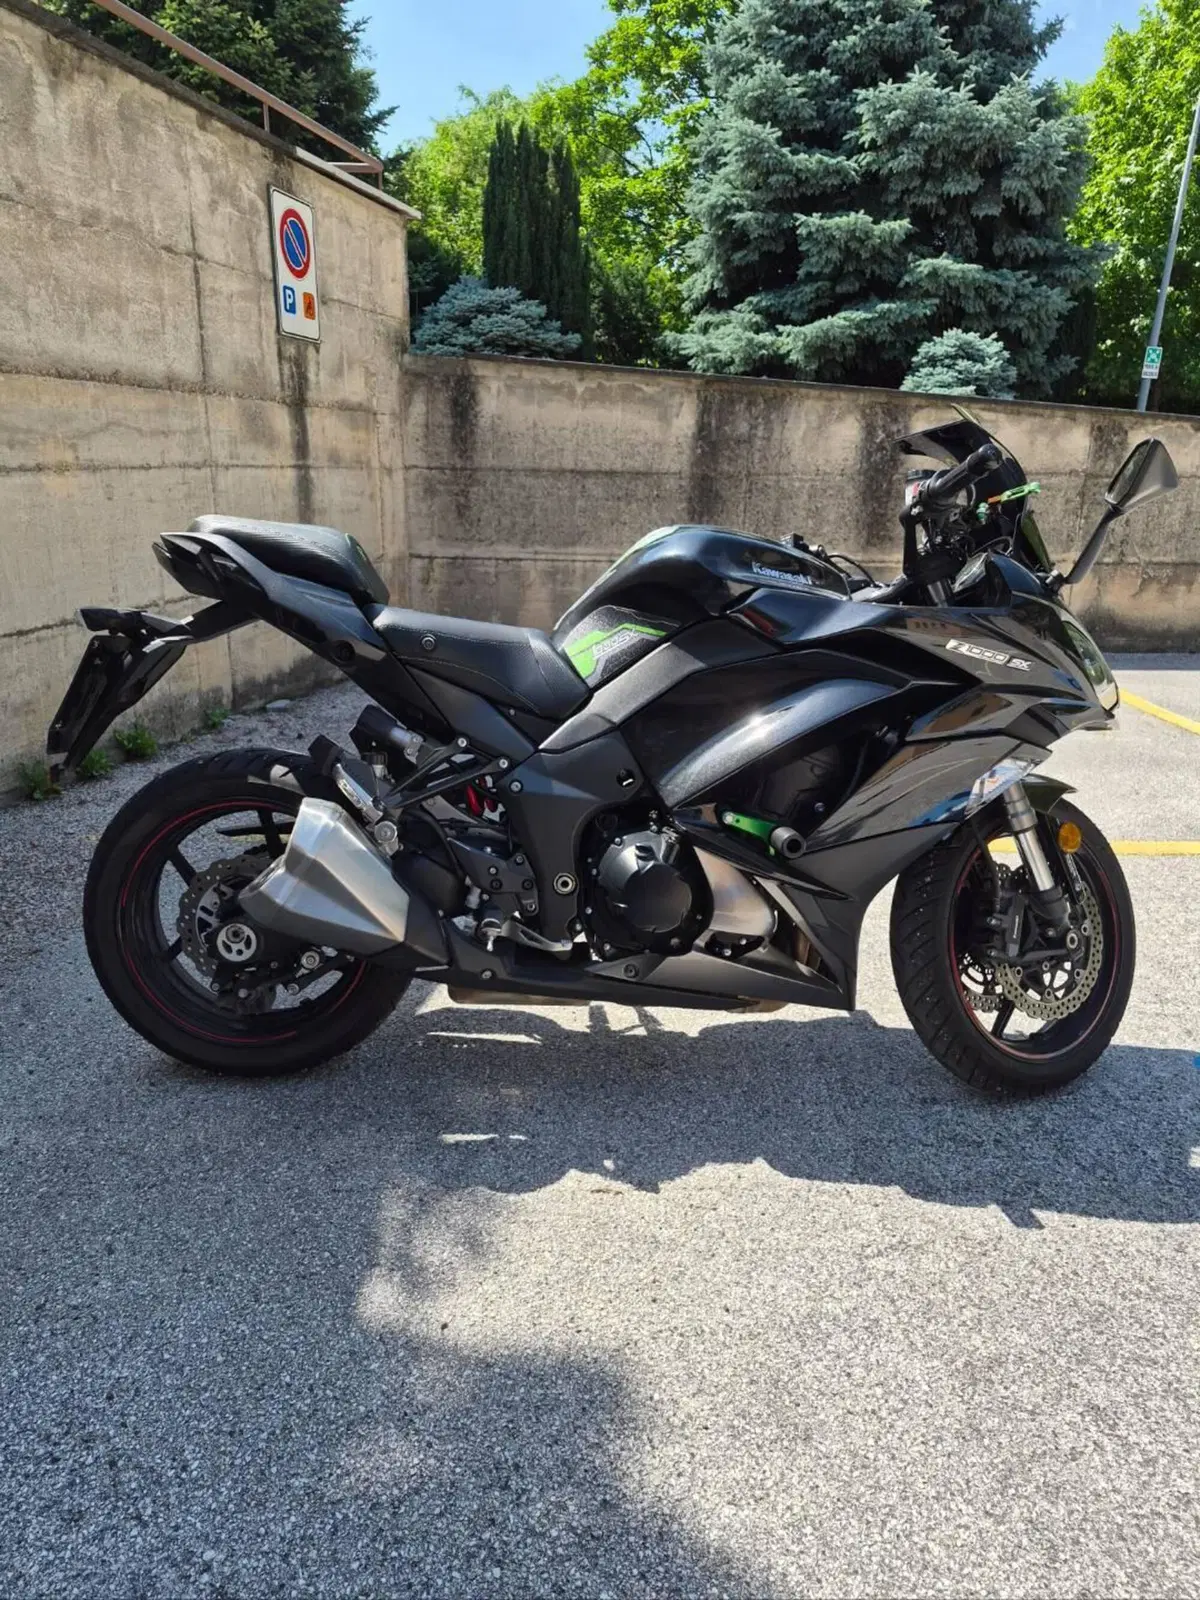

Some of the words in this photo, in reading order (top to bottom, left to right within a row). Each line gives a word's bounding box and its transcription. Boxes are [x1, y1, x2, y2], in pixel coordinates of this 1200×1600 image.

[285, 289, 295, 310] P
[751, 561, 813, 586] Kawasaki
[1006, 657, 1032, 672] SX
